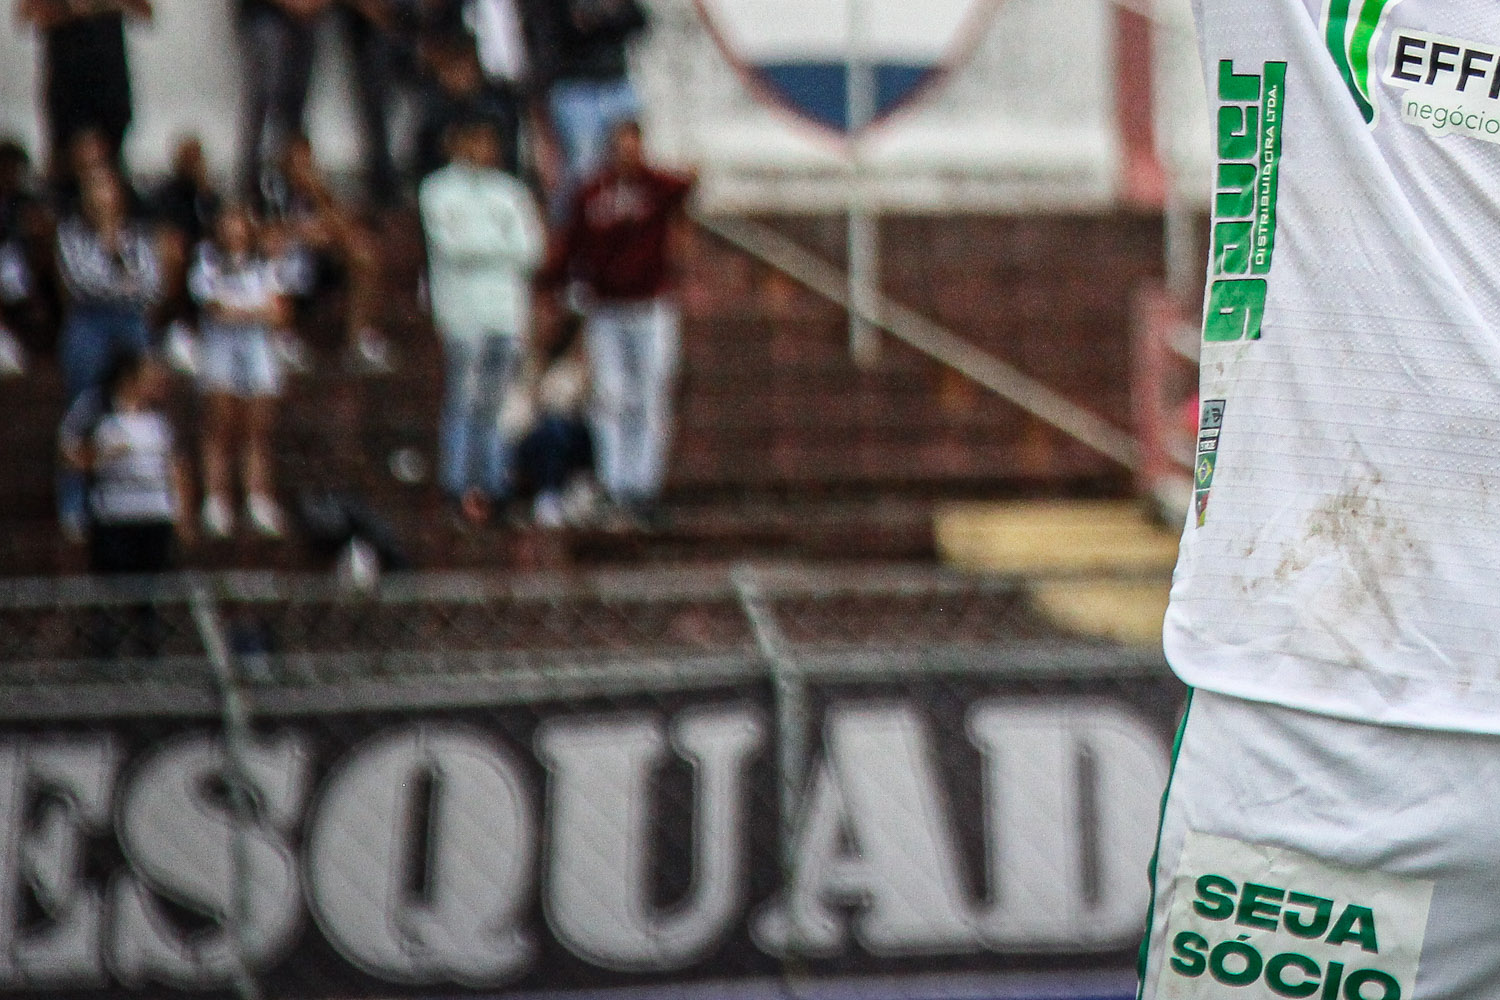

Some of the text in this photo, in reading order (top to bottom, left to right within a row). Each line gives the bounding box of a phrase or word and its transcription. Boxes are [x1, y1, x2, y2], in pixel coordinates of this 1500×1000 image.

[1203, 60, 1268, 342] gauer
[1255, 85, 1278, 265] DISTRIBUIDORA LTDA.
[1169, 931, 1402, 1000] SÓCIO
[1192, 873, 1379, 954] SEJA
